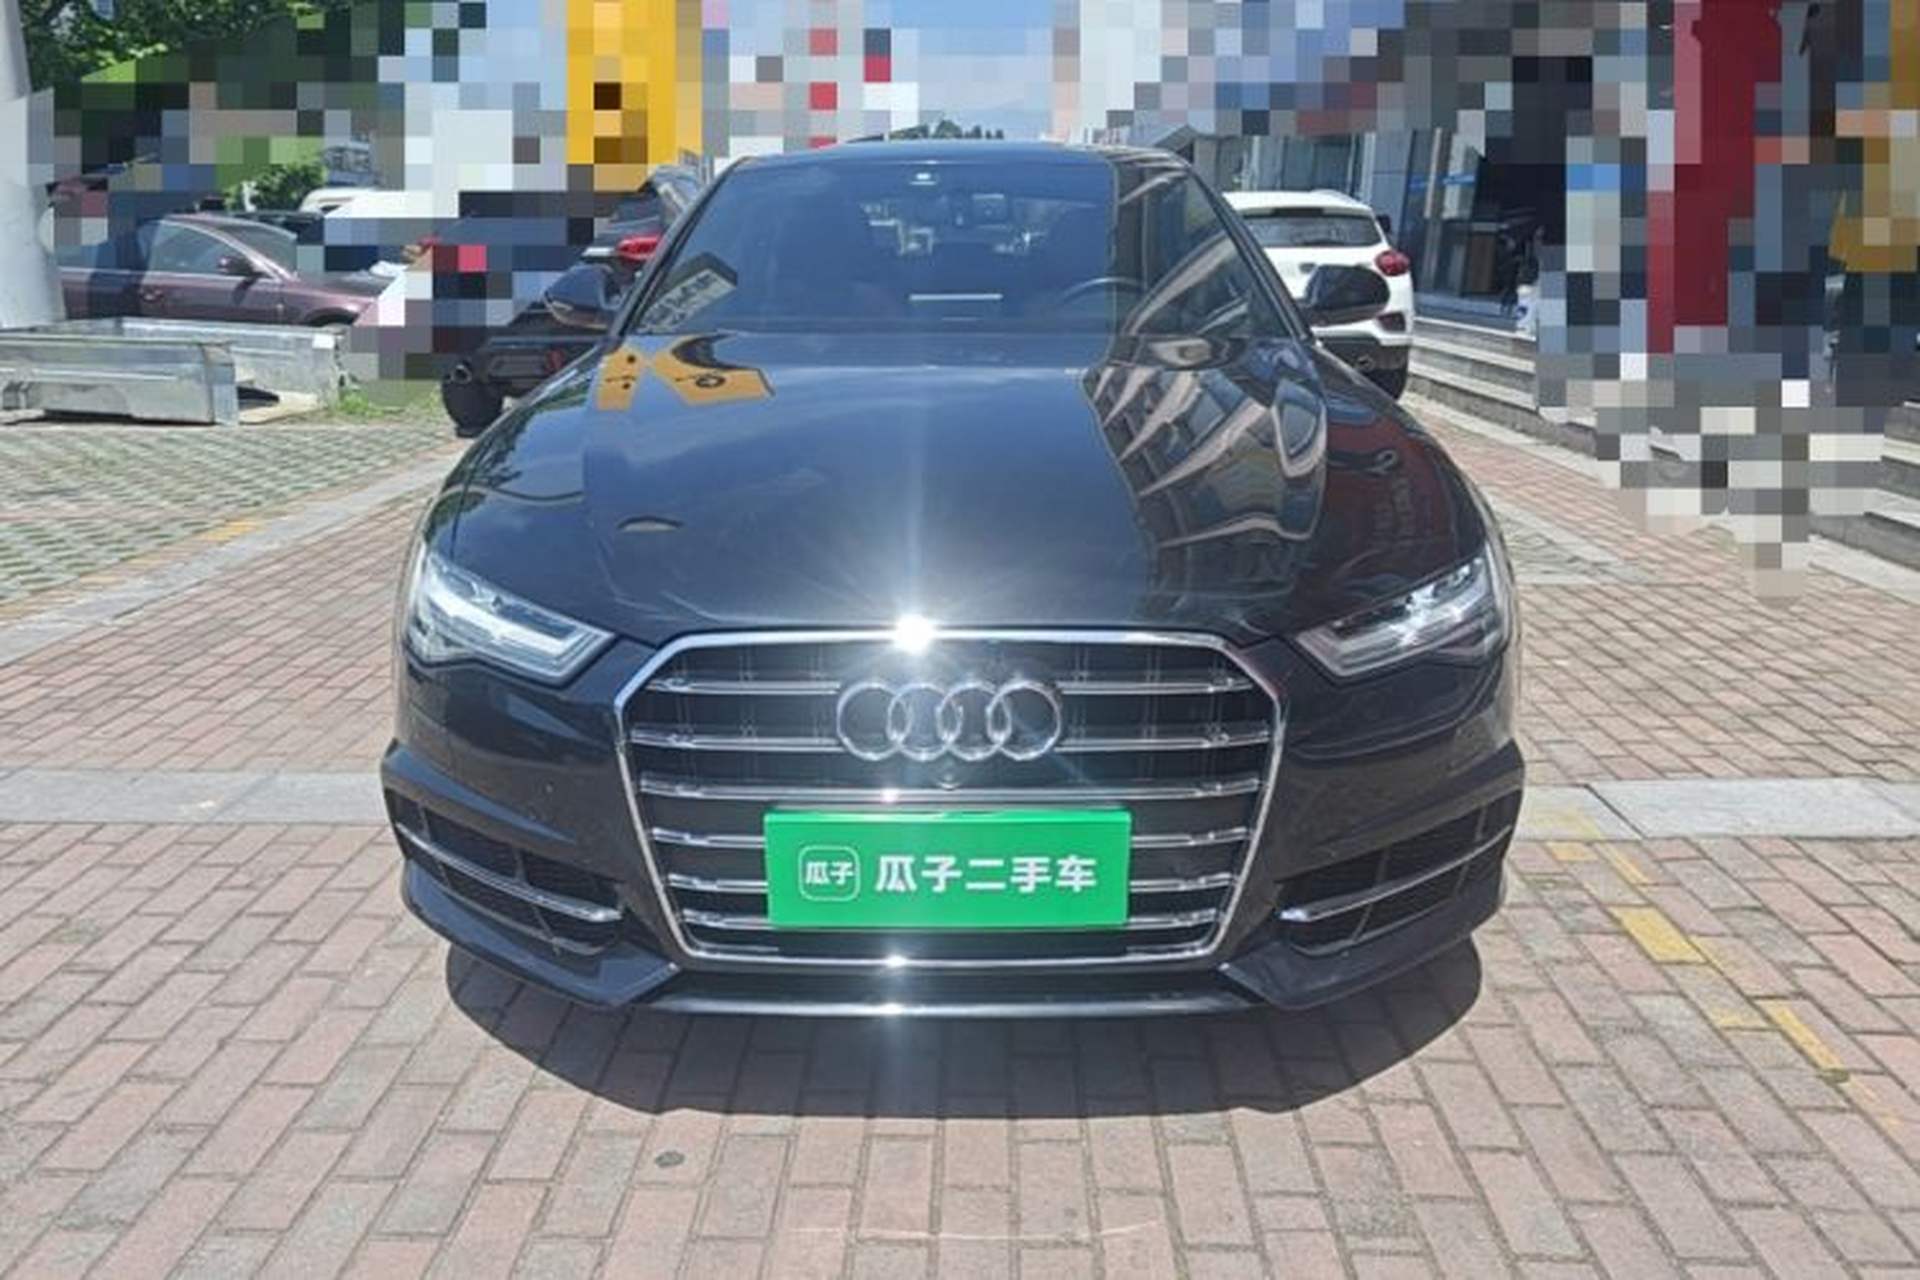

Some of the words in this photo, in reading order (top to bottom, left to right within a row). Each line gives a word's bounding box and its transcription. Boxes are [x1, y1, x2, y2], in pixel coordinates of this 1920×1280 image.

[805, 861, 854, 886] 瓜子
[875, 855, 1097, 893] 瓜子二手车
